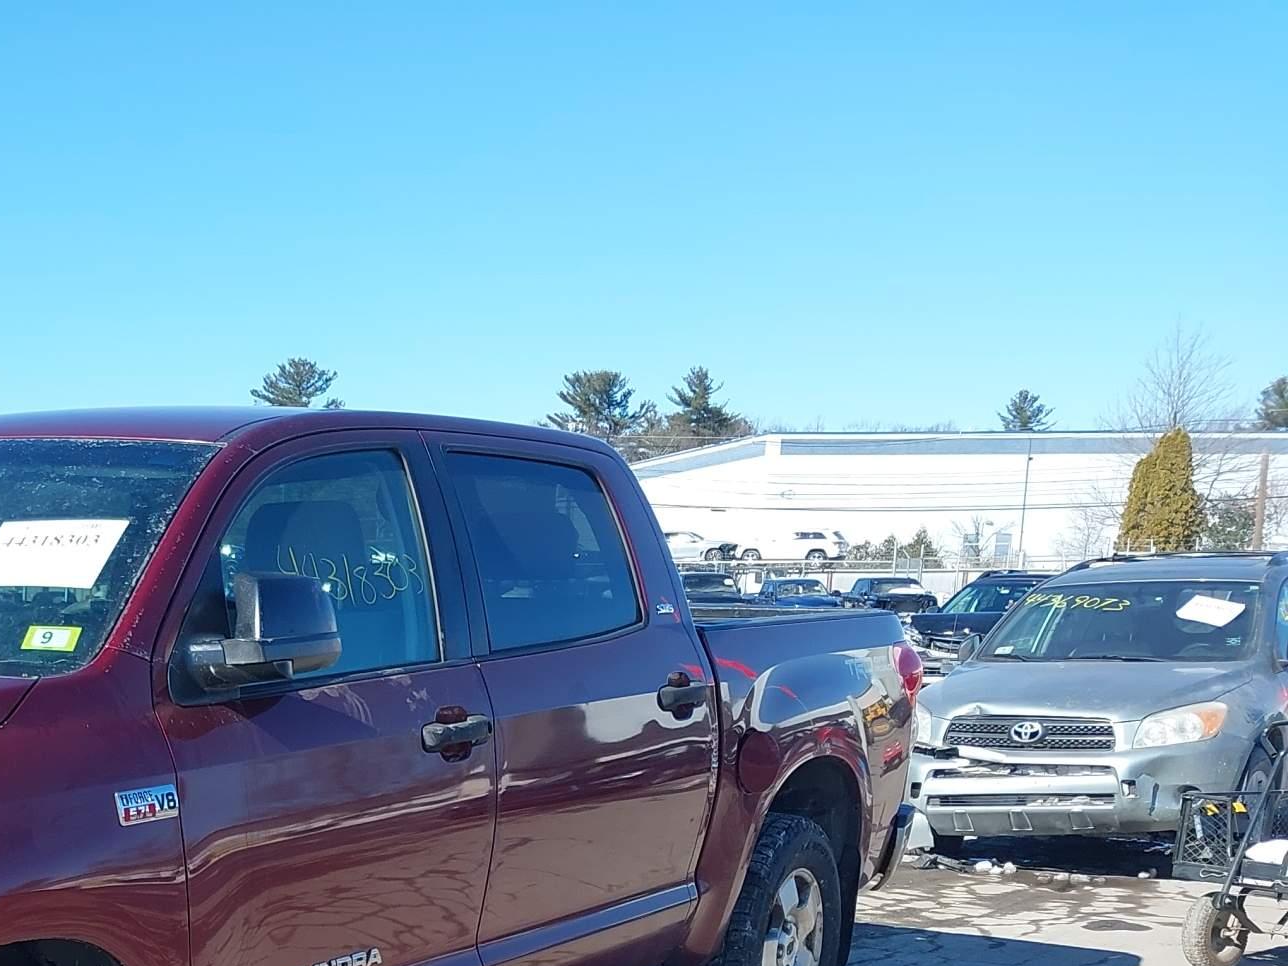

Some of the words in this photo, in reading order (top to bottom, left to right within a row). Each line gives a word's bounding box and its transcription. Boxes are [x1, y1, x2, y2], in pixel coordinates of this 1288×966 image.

[1, 533, 102, 548] 44318303
[40, 630, 54, 645] 9
[155, 792, 177, 811] V8
